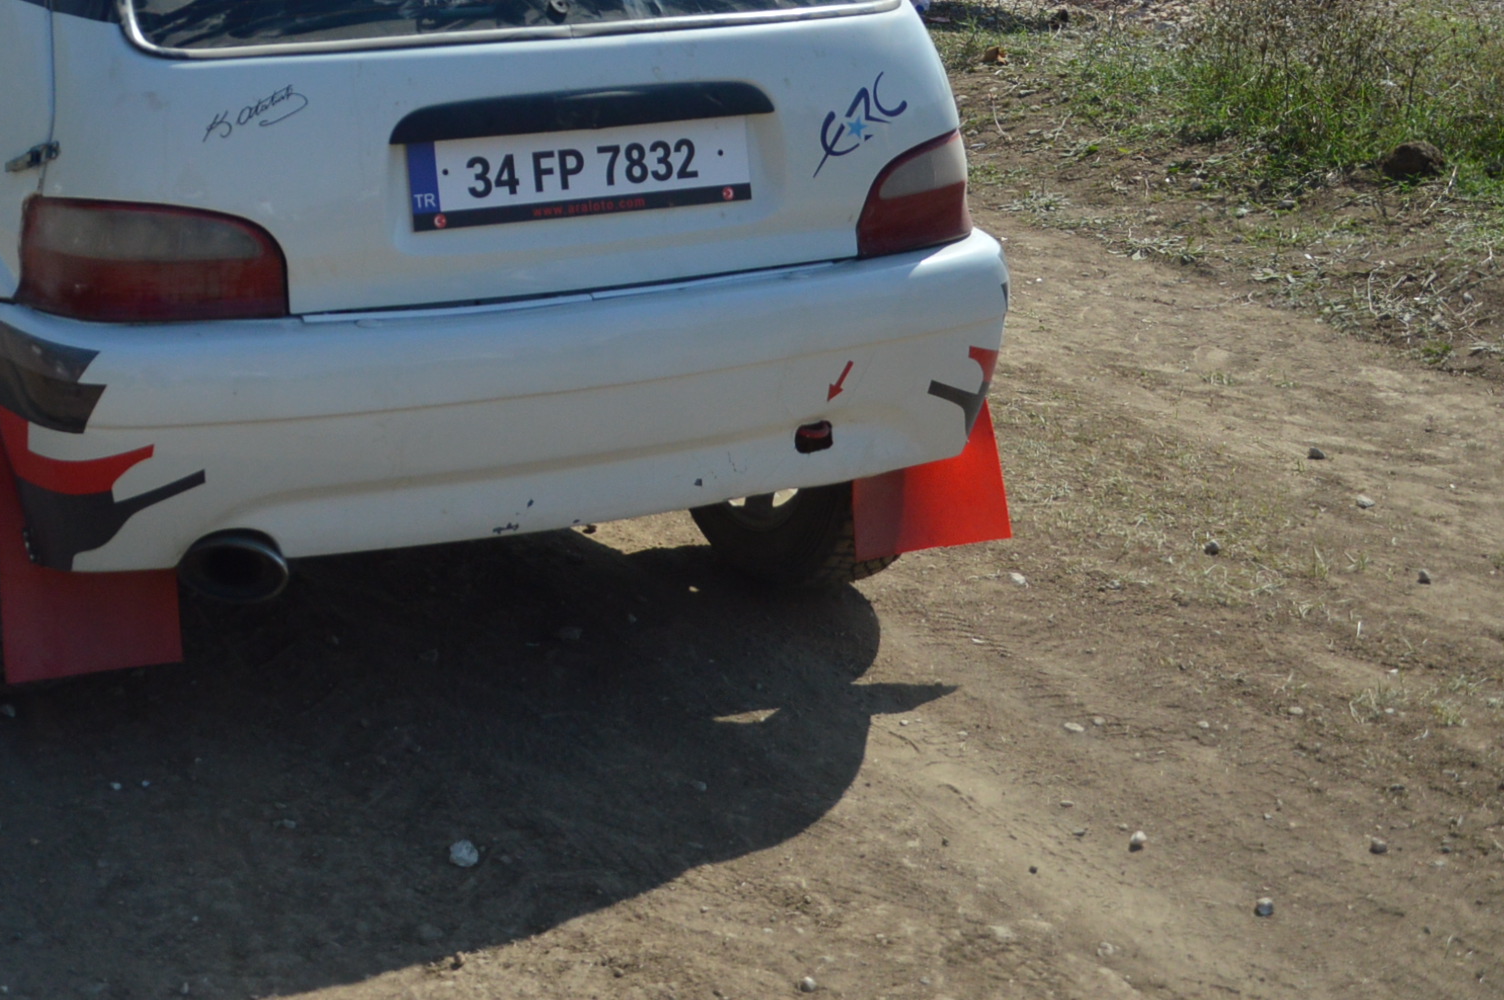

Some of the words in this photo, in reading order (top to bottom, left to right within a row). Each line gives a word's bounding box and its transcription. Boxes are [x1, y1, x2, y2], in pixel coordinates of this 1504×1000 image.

[466, 153, 520, 198] 34
[532, 148, 585, 193] FP
[597, 138, 699, 186] 7832
[413, 193, 436, 208] TR
[532, 196, 646, 217] www.araloto.com
